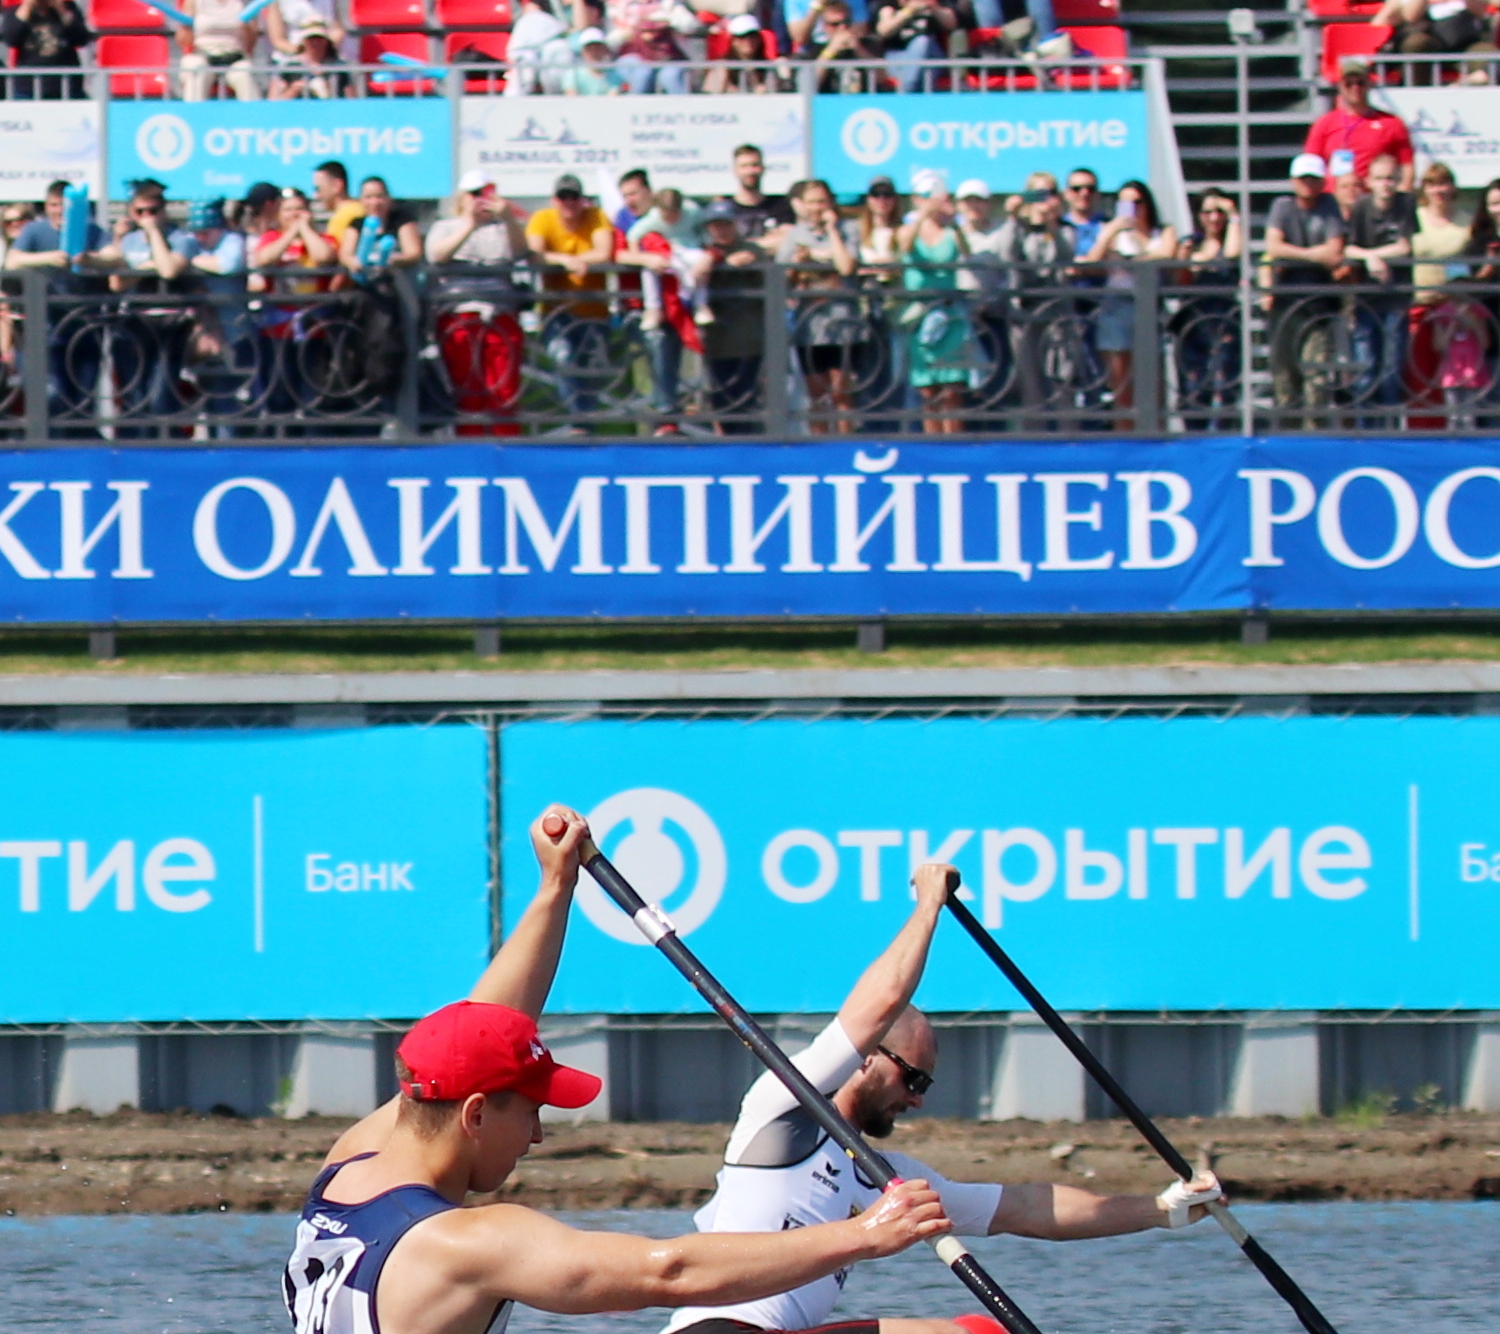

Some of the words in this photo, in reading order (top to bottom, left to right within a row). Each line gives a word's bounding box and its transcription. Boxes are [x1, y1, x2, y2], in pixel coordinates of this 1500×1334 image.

[203, 125, 423, 165] открытие
[478, 151, 565, 164] BARNAUL
[573, 149, 620, 163] 2021
[910, 119, 1128, 158] открытие
[191, 446, 1197, 581] ОЛИМПИЙЦЕВ
[305, 852, 416, 894] Банк
[761, 824, 1371, 929] открытие
[812, 1170, 841, 1194] erima
[310, 1213, 349, 1235] 2XU
